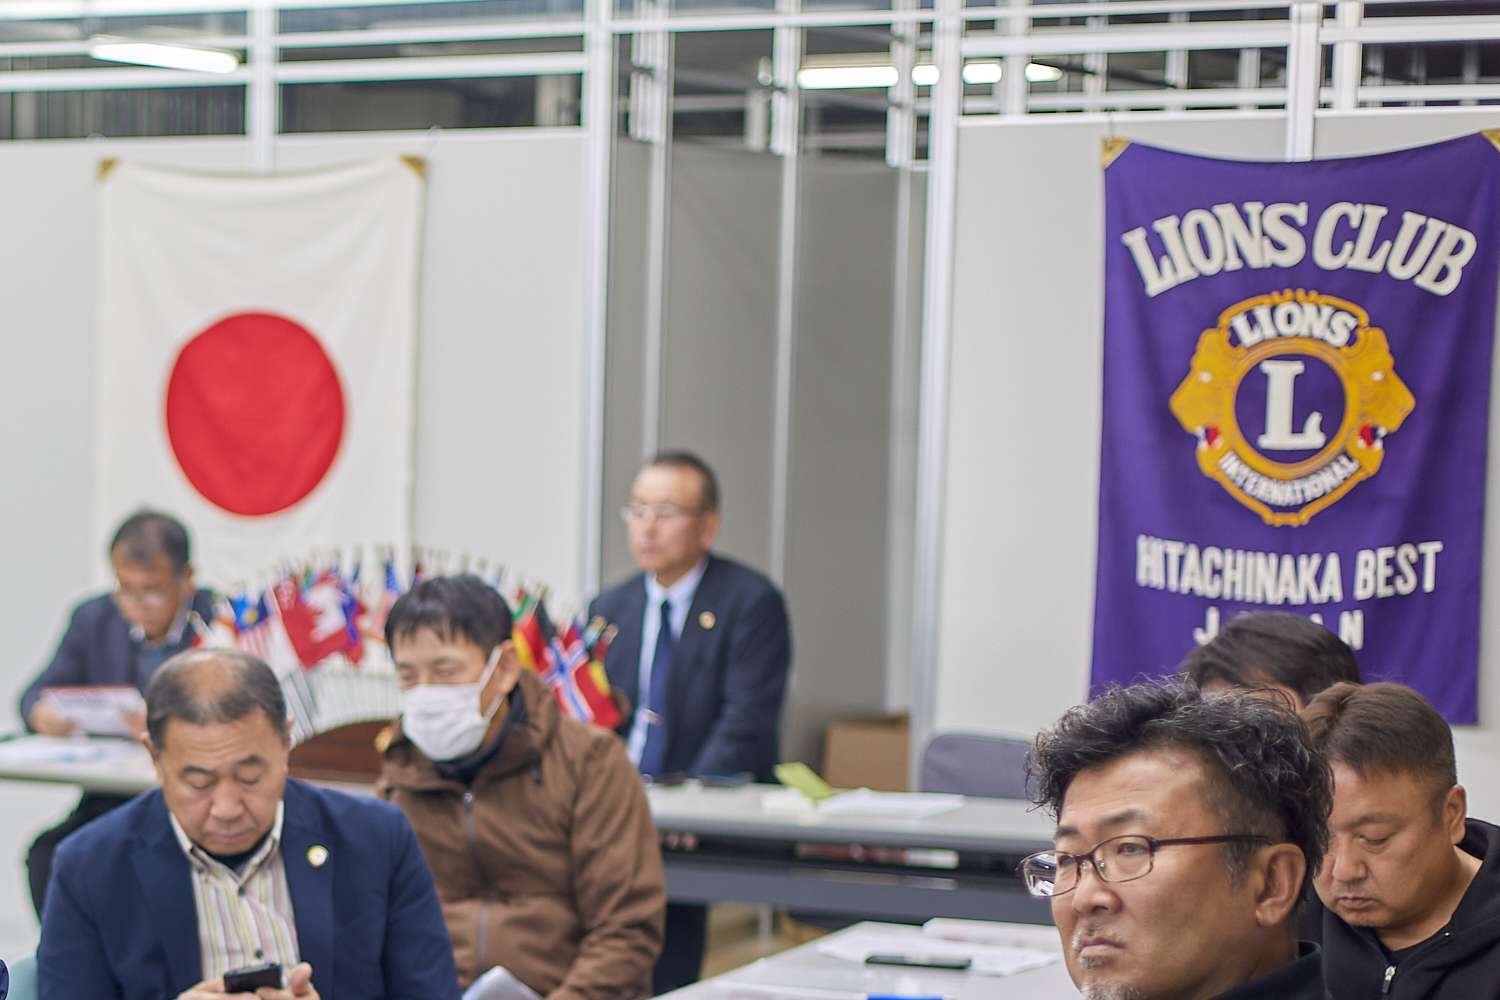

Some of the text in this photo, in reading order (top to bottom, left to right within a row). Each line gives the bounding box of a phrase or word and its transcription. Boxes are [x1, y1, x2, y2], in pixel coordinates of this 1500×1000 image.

[1121, 201, 1478, 298] LIONS CLUB
[1231, 301, 1358, 348] LIONS
[1257, 359, 1326, 450] L
[1218, 450, 1361, 507] INTERNATIONAL
[1136, 533, 1444, 605] HITACHINAKA BEST
